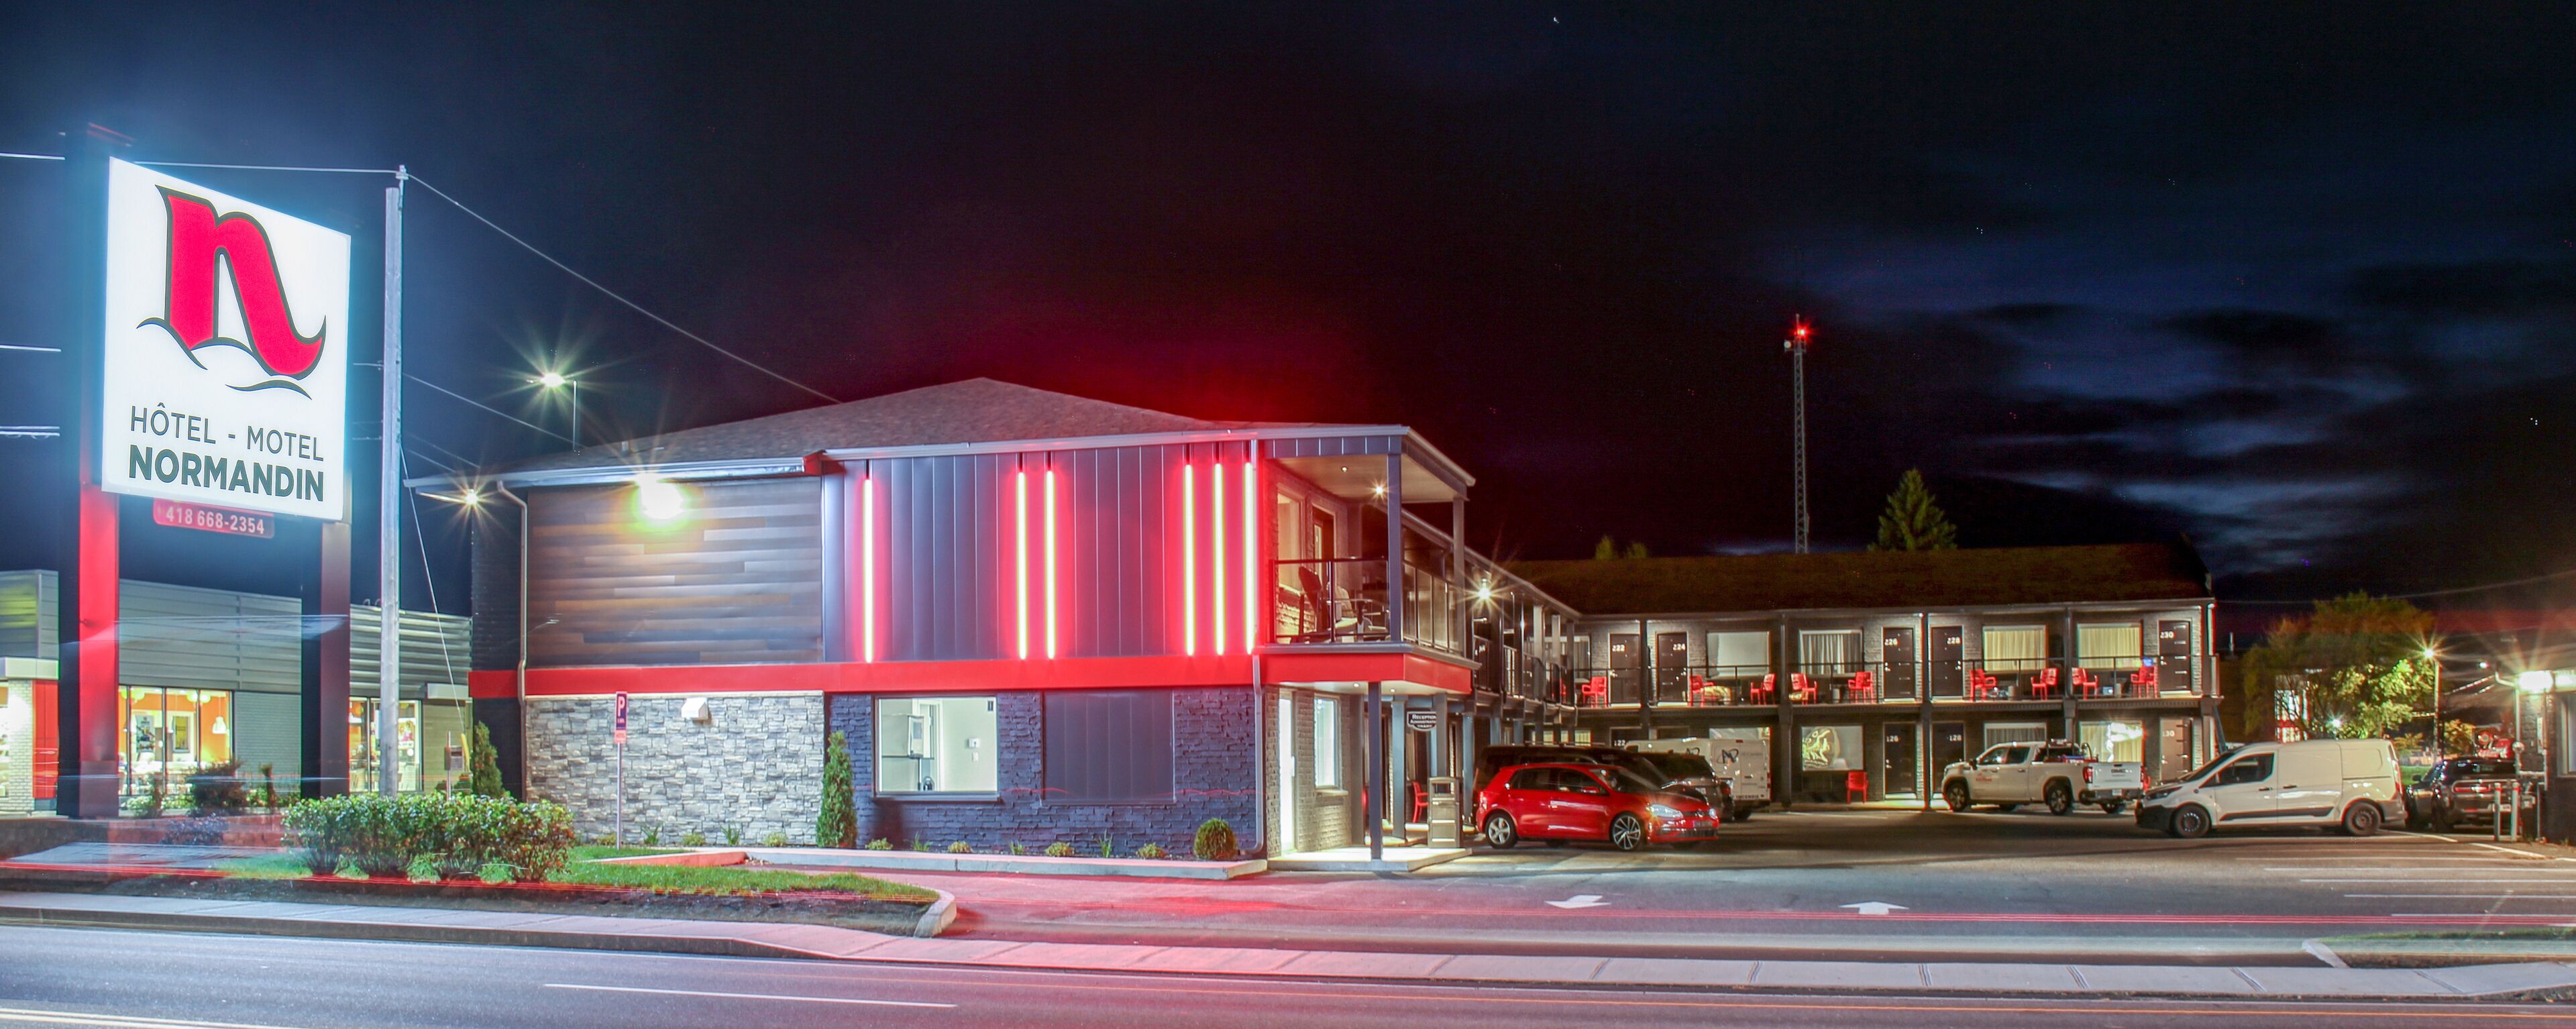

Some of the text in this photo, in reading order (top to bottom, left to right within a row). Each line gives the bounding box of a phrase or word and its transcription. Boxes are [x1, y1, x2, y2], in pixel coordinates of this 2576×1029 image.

[130, 402, 217, 444] HÔTEL
[247, 425, 324, 462] MOTEL
[129, 444, 324, 502] NORMANDIN
[166, 506, 264, 535] 418 668-2354
[1612, 644, 1625, 652] 222
[1884, 638, 1898, 646] 226
[618, 696, 625, 717] P
